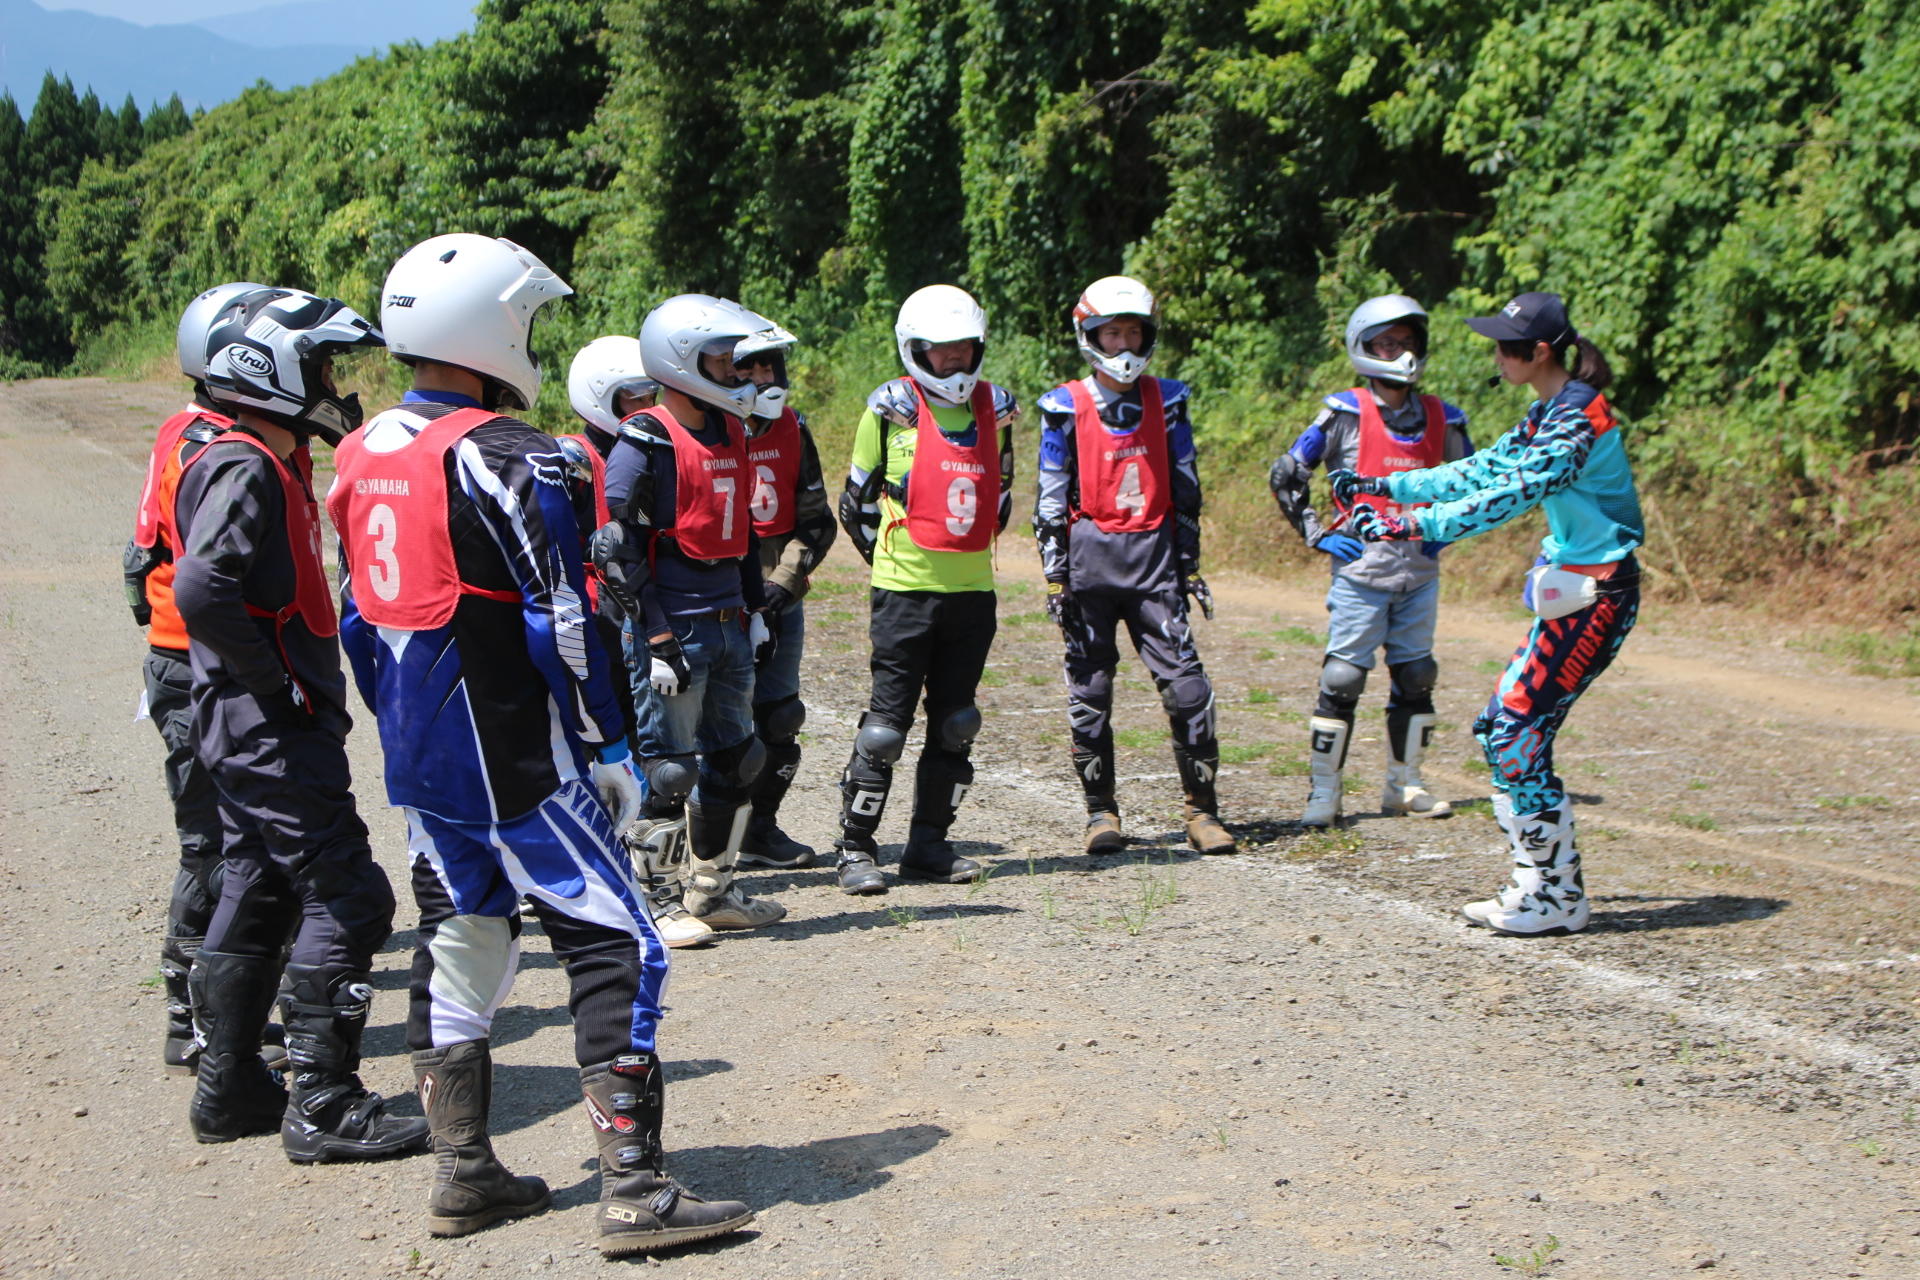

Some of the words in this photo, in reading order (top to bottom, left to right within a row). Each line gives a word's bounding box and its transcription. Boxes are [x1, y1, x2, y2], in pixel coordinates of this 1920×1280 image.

[231, 350, 268, 370] Arai
[711, 457, 738, 470] YAMAHA
[1113, 446, 1148, 460] YAMAHA
[367, 479, 410, 496] YAMAHA
[751, 465, 779, 521] 6
[1115, 463, 1146, 517] 4
[712, 477, 736, 540] 7
[945, 477, 977, 536] 9
[367, 503, 400, 602] 3
[851, 790, 884, 816] G
[570, 783, 633, 883] YAMAHA
[617, 1055, 649, 1067] SIDI
[605, 1206, 638, 1225] SIDI
